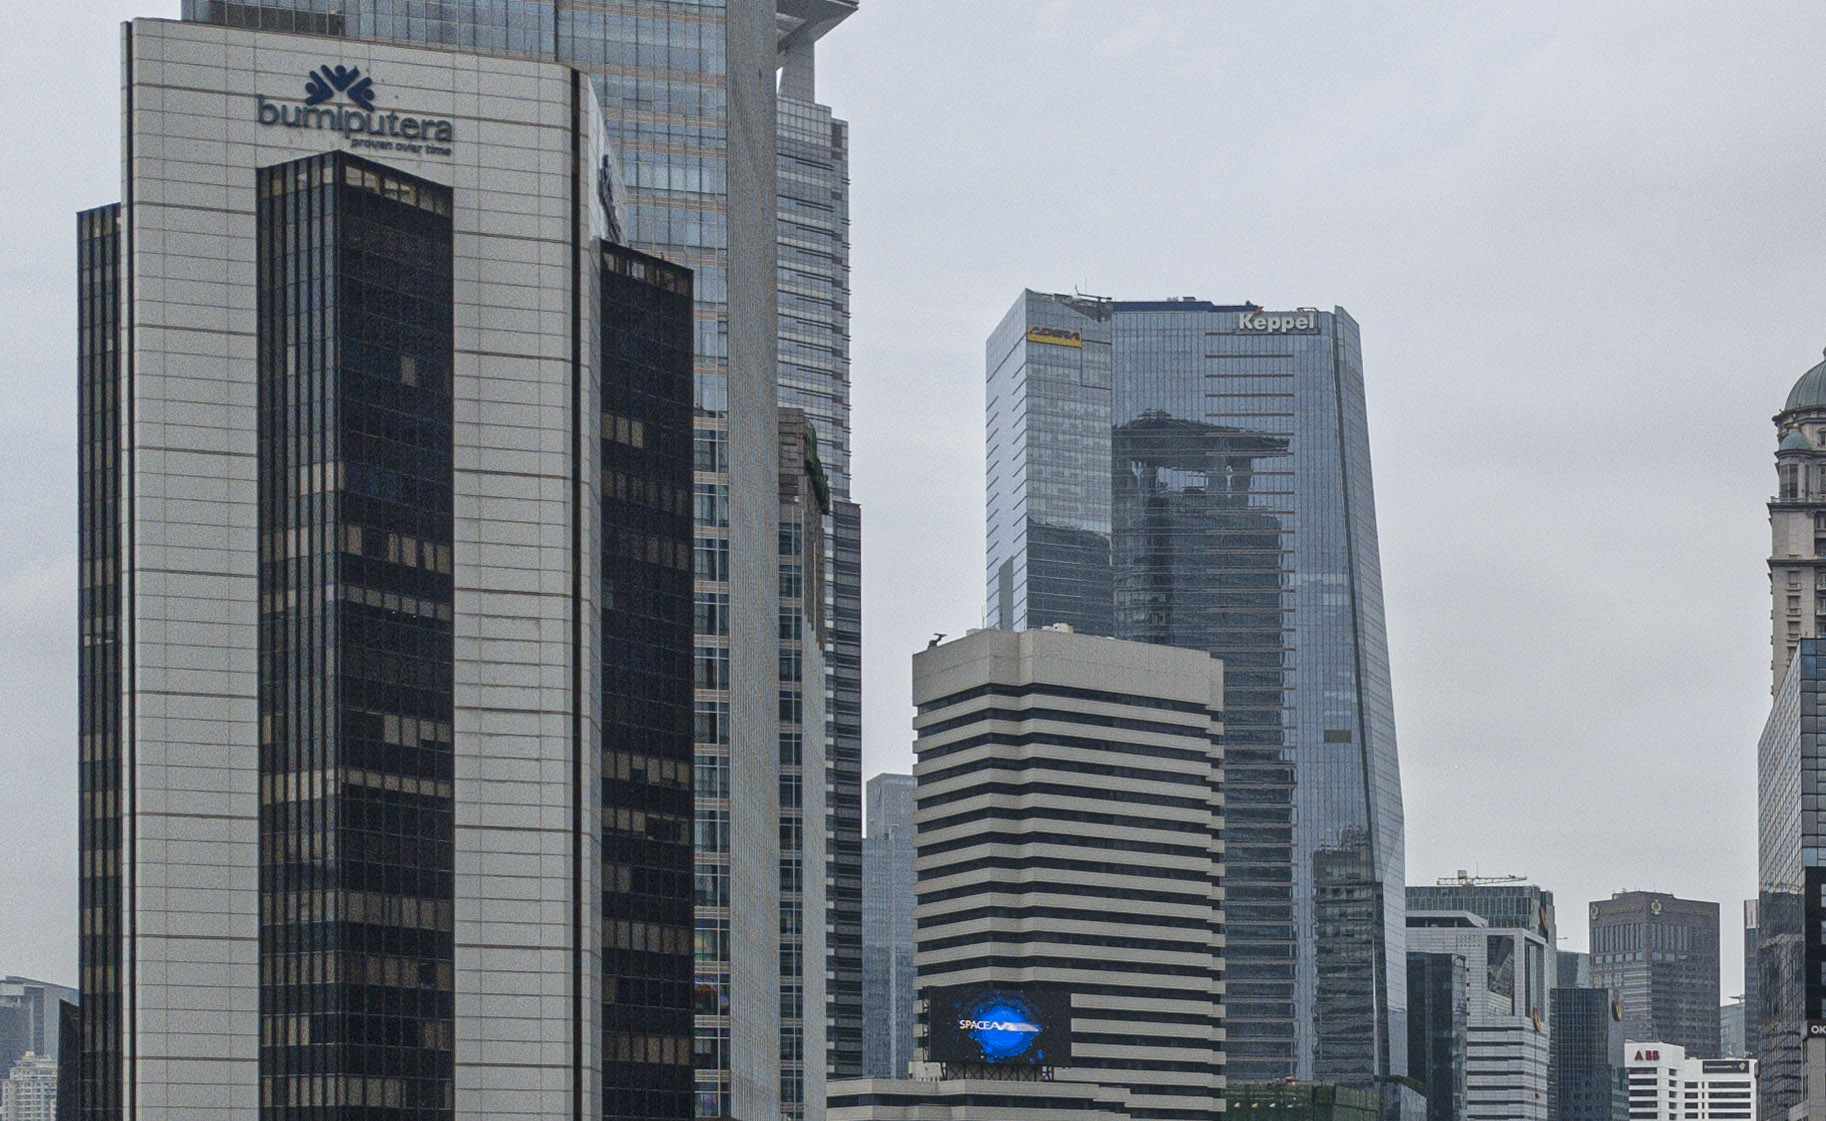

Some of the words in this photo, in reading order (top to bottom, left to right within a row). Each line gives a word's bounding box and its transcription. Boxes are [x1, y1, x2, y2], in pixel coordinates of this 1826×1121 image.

[257, 94, 453, 142] bumiputera
[351, 138, 393, 151] proven
[395, 142, 423, 154] over
[425, 143, 452, 157] time
[1239, 312, 1315, 333] Keppel
[1811, 1025, 1826, 1034] OK
[1634, 1050, 1660, 1061] ABB
